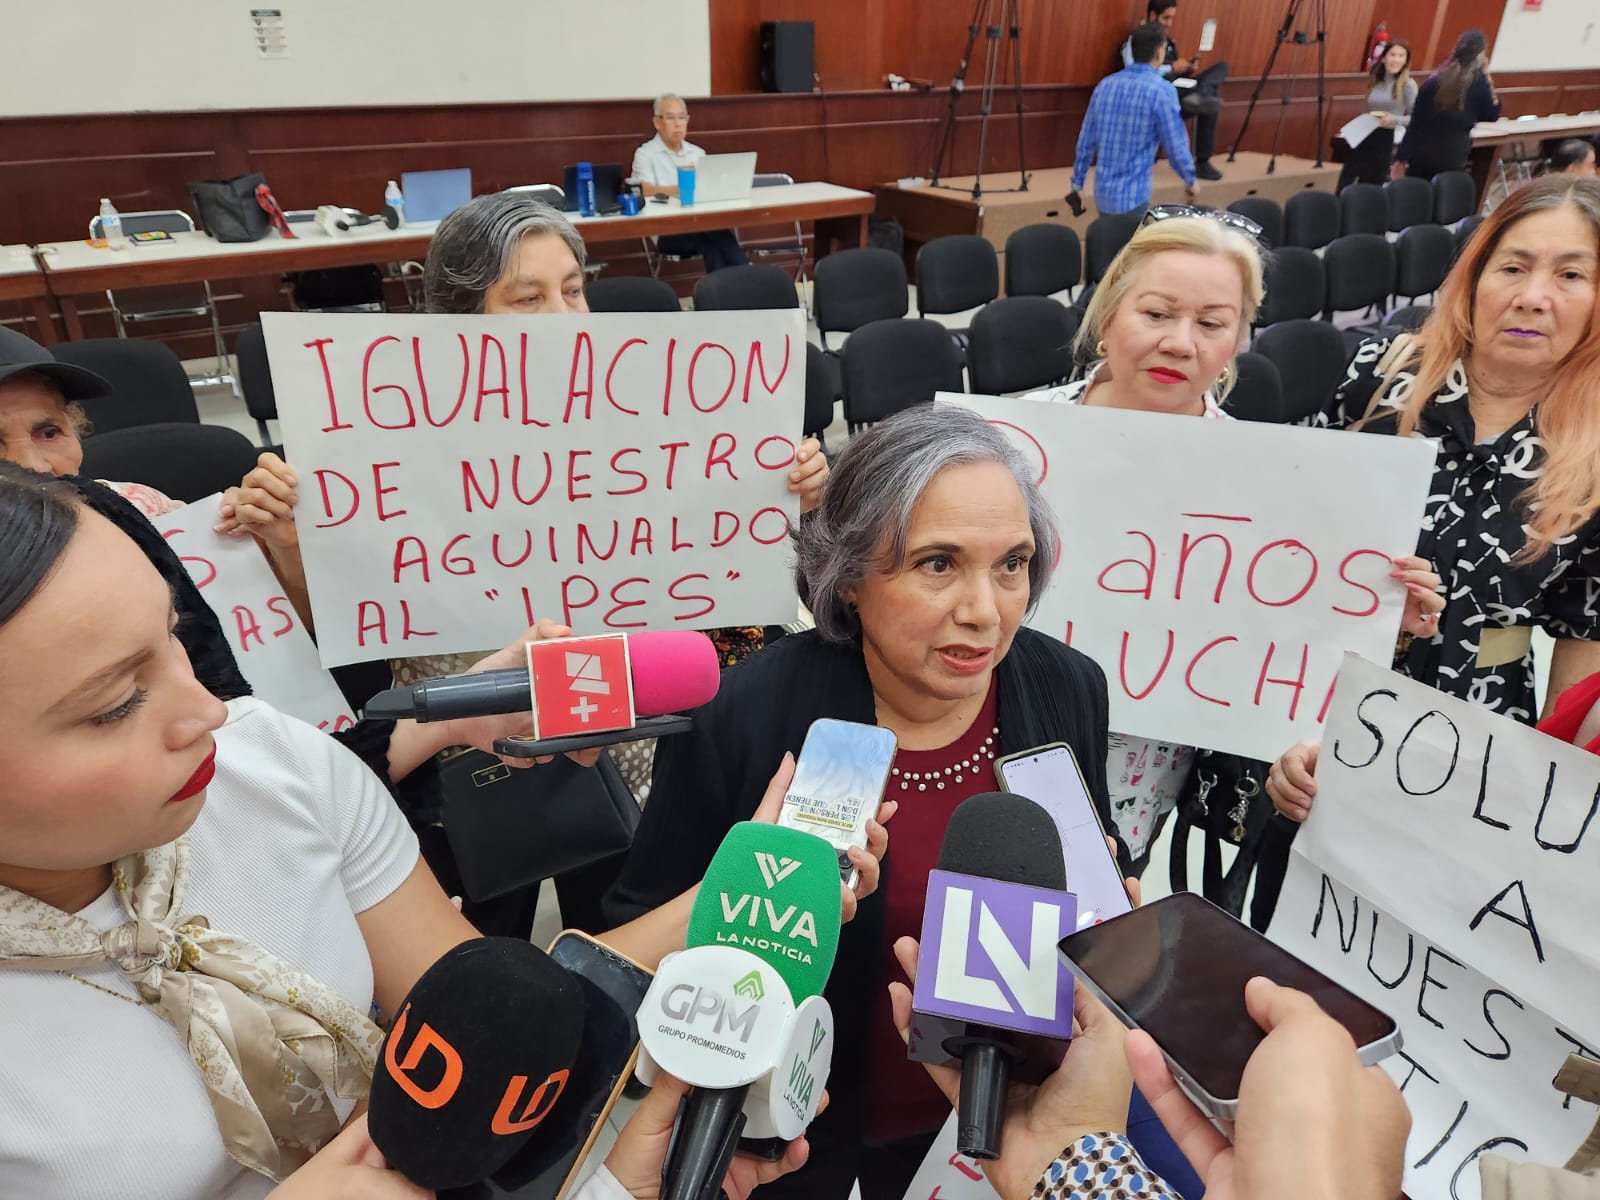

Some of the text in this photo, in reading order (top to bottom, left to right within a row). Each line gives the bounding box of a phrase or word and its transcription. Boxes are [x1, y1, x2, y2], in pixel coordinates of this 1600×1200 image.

[304, 331, 790, 432] IGUALACION
[313, 433, 796, 528] DE NUESTRO
[393, 506, 790, 584] AGUINALDO
[1097, 512, 1396, 617] años
[357, 599, 439, 647] AL
[716, 931, 812, 965] LA NOTICIA
[720, 892, 818, 948] VIVA
[1469, 880, 1544, 964] A
[658, 1024, 747, 1060] GRUPO PROMOMEDIOS
[661, 983, 760, 1043] GPM
[789, 1052, 815, 1111] VIVA
